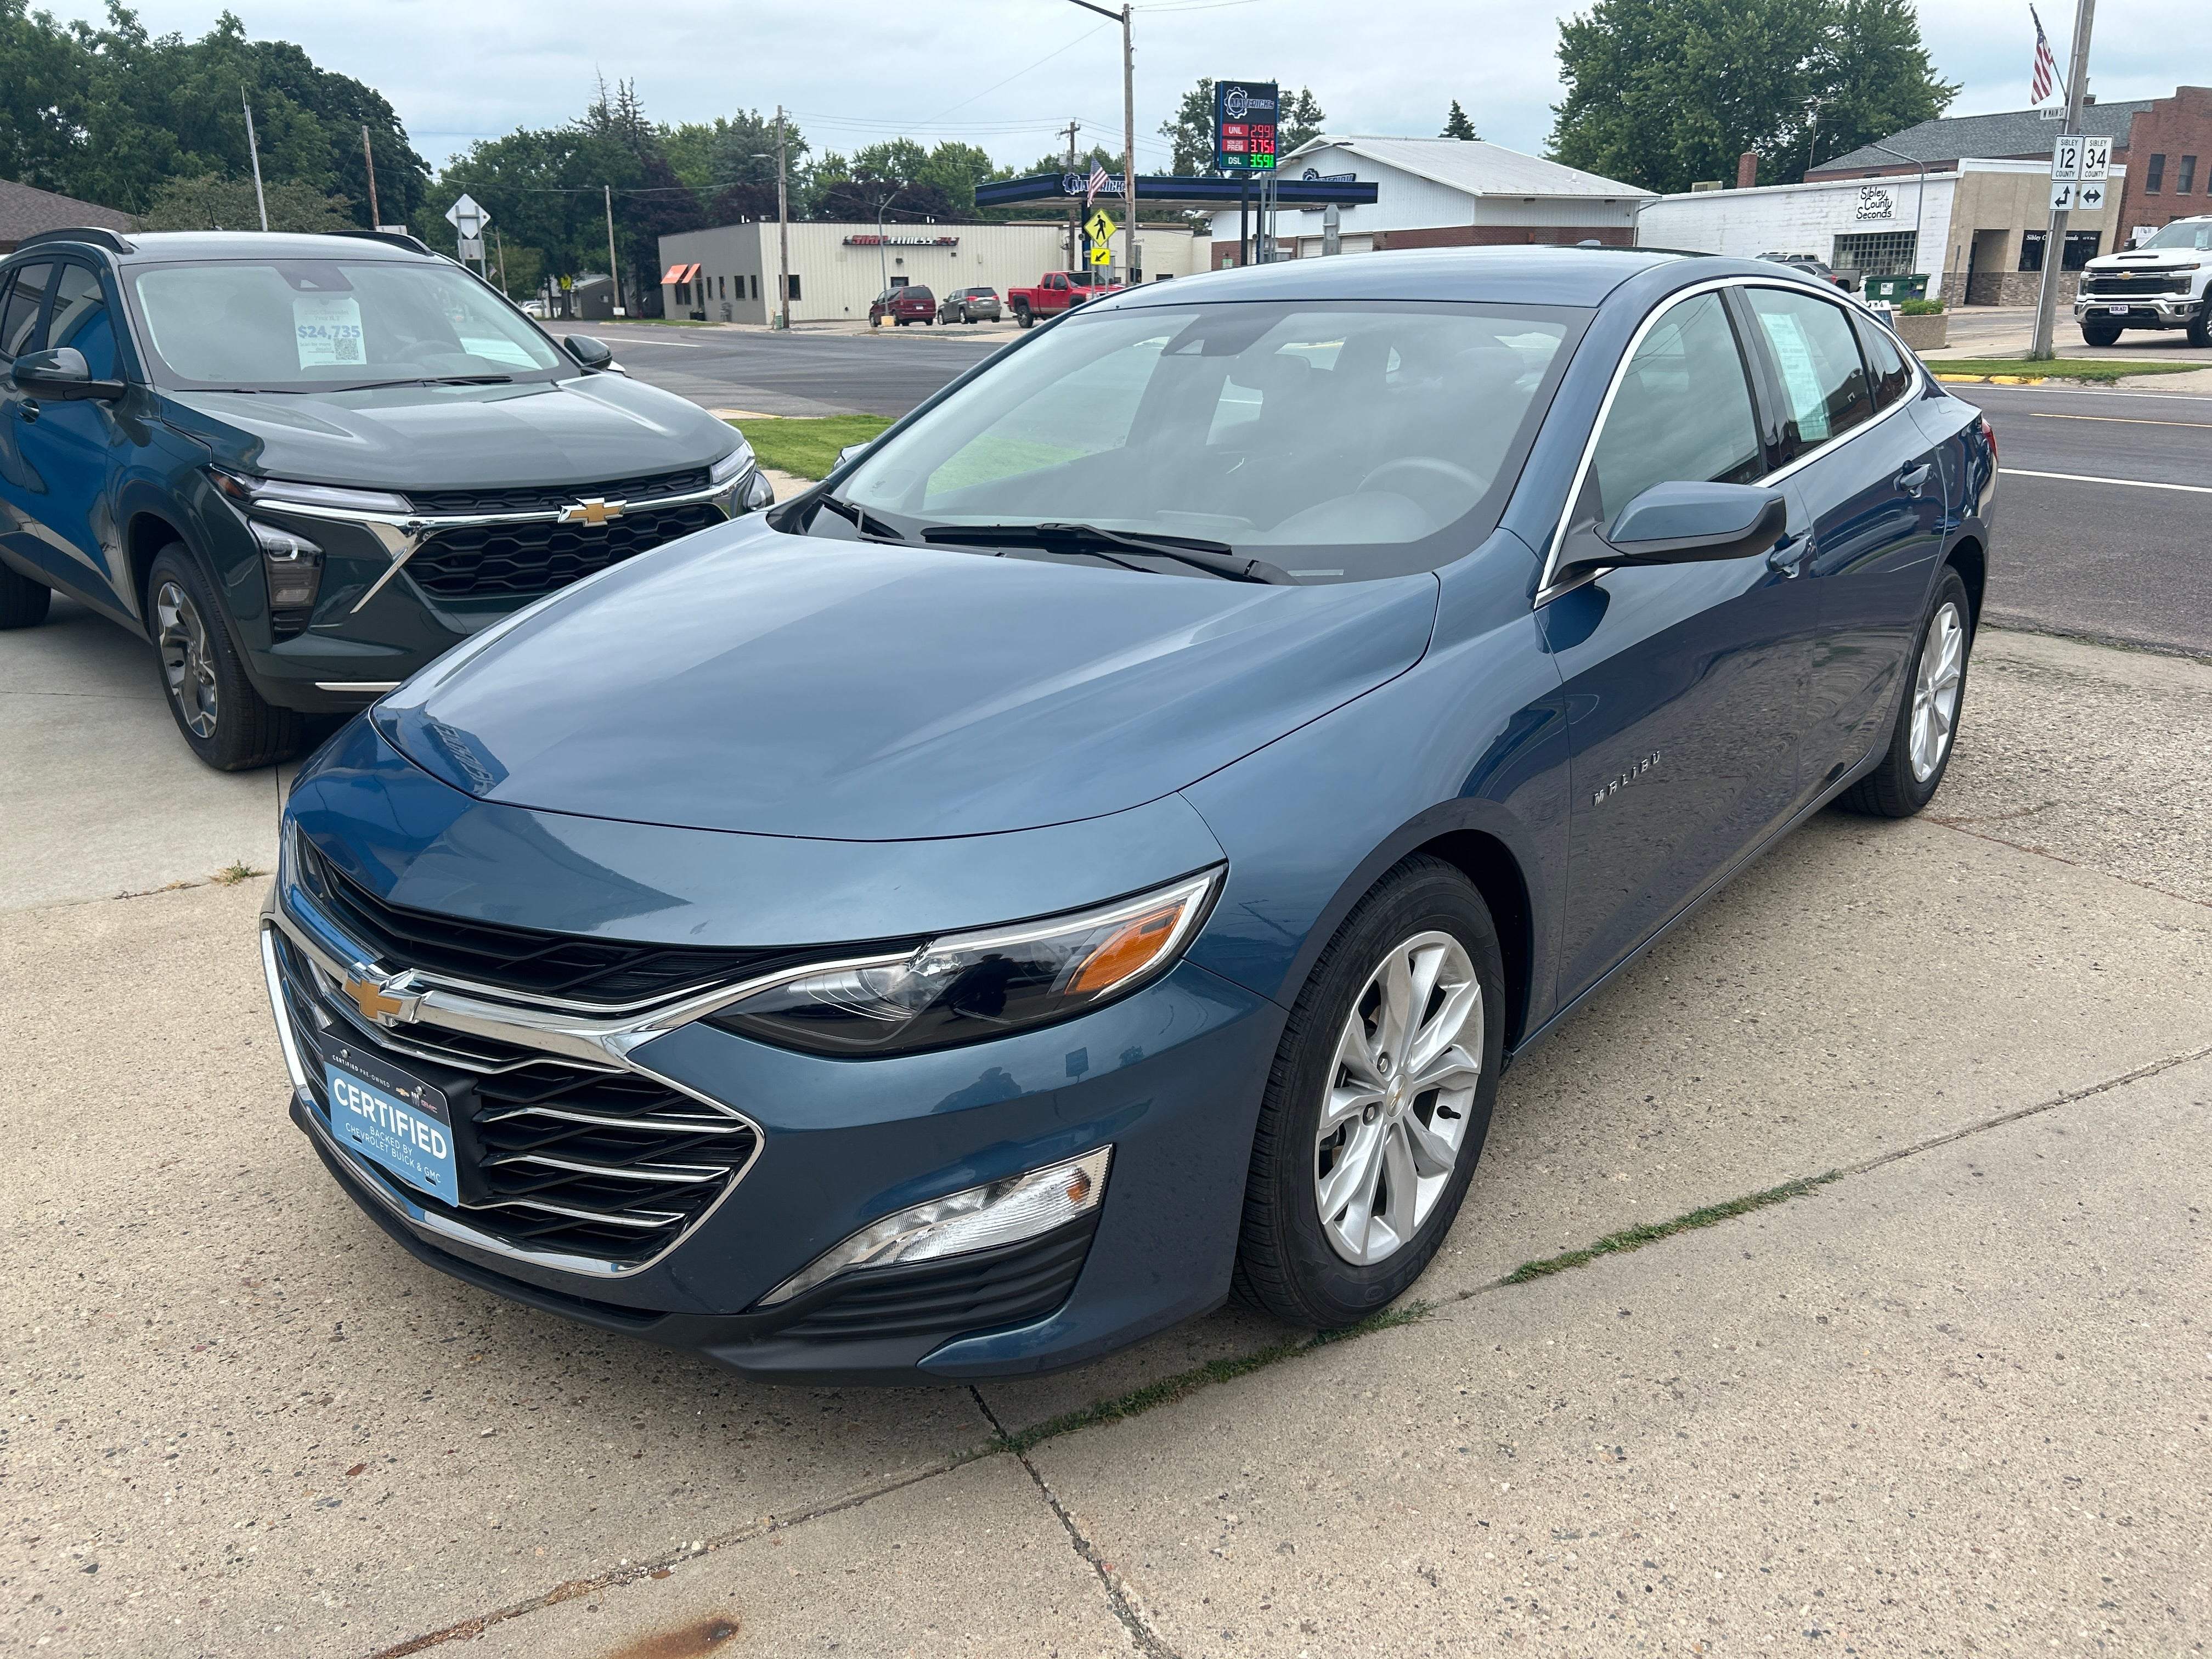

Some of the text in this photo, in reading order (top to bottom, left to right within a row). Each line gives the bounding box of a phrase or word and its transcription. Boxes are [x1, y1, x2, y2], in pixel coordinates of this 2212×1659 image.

[2043, 108, 2064, 118] W MAIN ST
[1228, 126, 1243, 134] UNL
[1228, 157, 1242, 165] DSL
[2060, 148, 2075, 168] 12
[2086, 148, 2107, 169] 34
[1860, 186, 1887, 201] Sibley
[1864, 195, 1893, 211] County
[1856, 206, 1892, 219] Seconds
[298, 325, 360, 340] $24,735
[1593, 751, 1660, 806] MALIBU
[332, 1054, 390, 1088] CERTIFIED PRE-OWNED
[334, 1077, 447, 1160] CERTIFIED
[370, 1126, 413, 1156] BACKED BY
[346, 1122, 441, 1183] CHEVROLET BUICK & GMC
